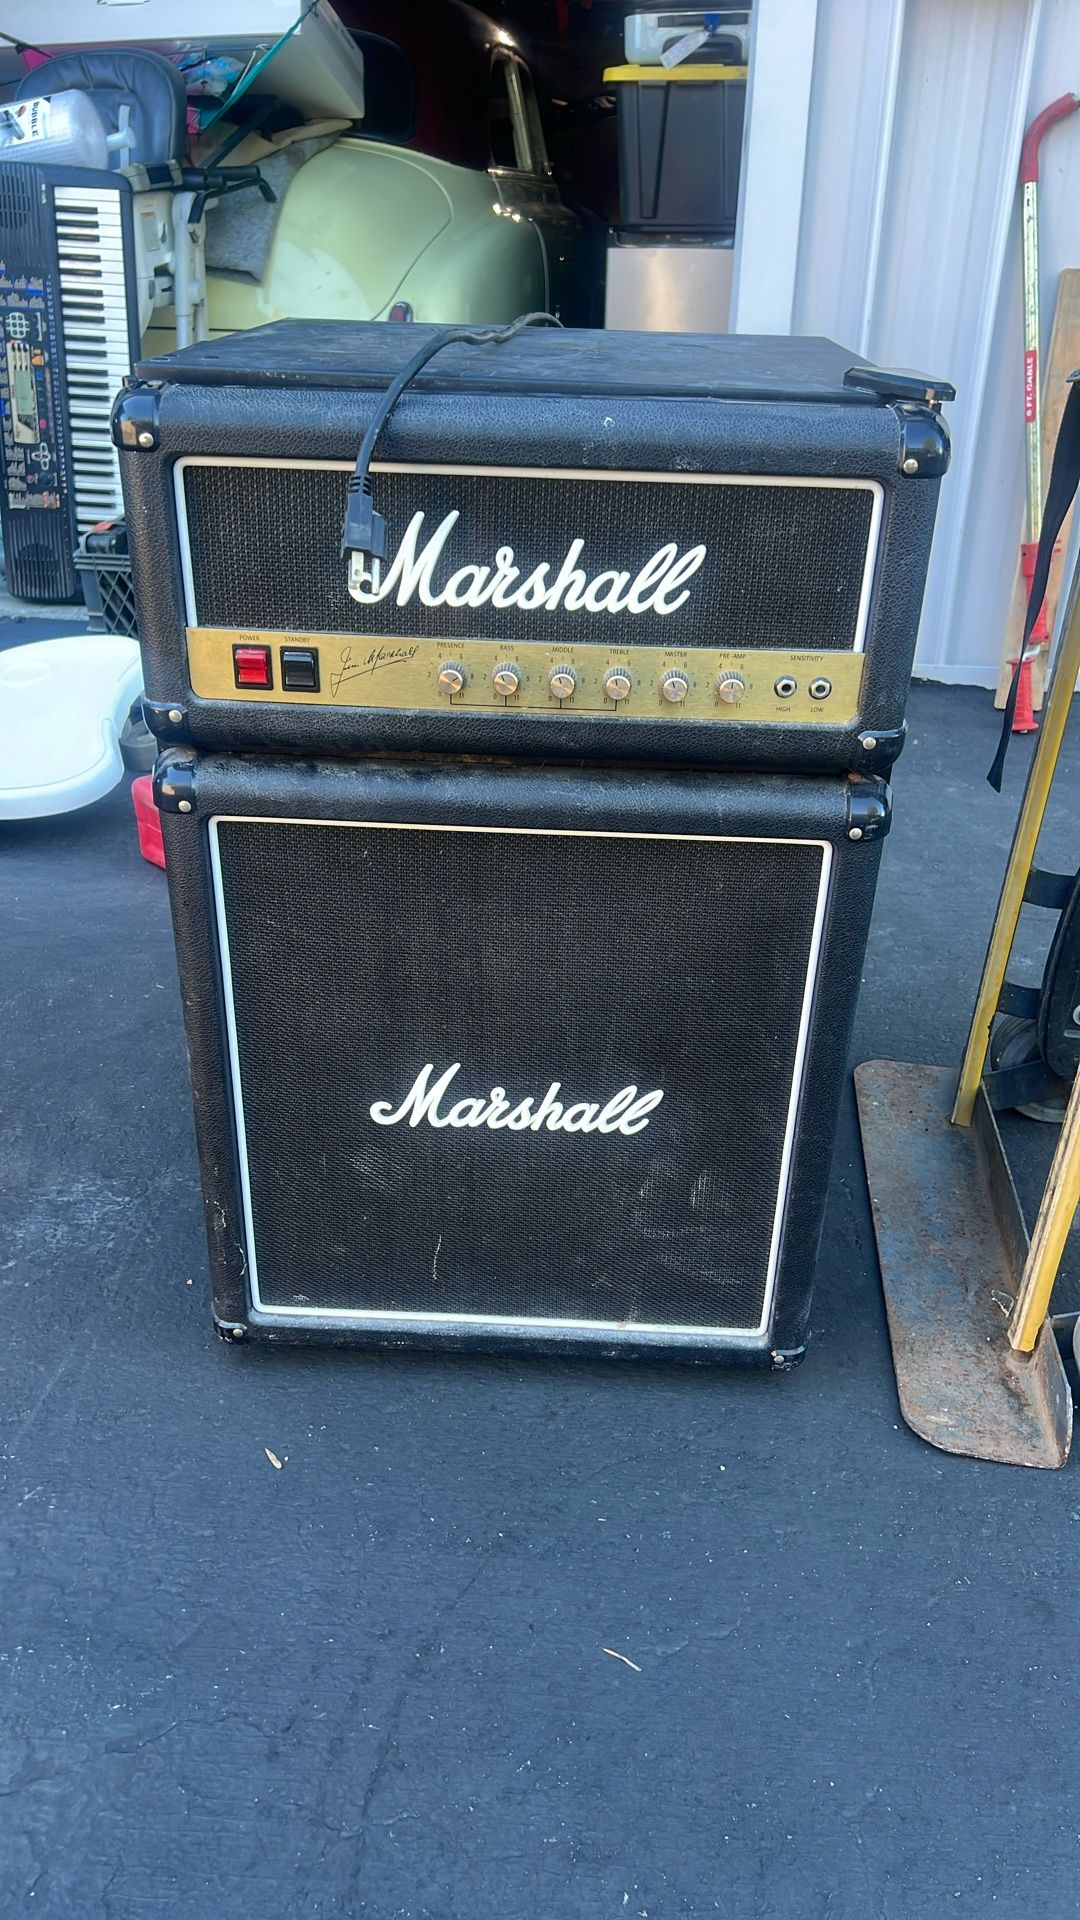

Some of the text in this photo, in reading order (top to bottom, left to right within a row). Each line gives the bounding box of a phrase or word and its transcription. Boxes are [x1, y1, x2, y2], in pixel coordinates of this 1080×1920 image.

[31, 101, 40, 137] BUBBLE
[348, 510, 706, 615] Marshall
[436, 641, 464, 649] PRESENCE
[369, 1062, 664, 1135] Marshall
